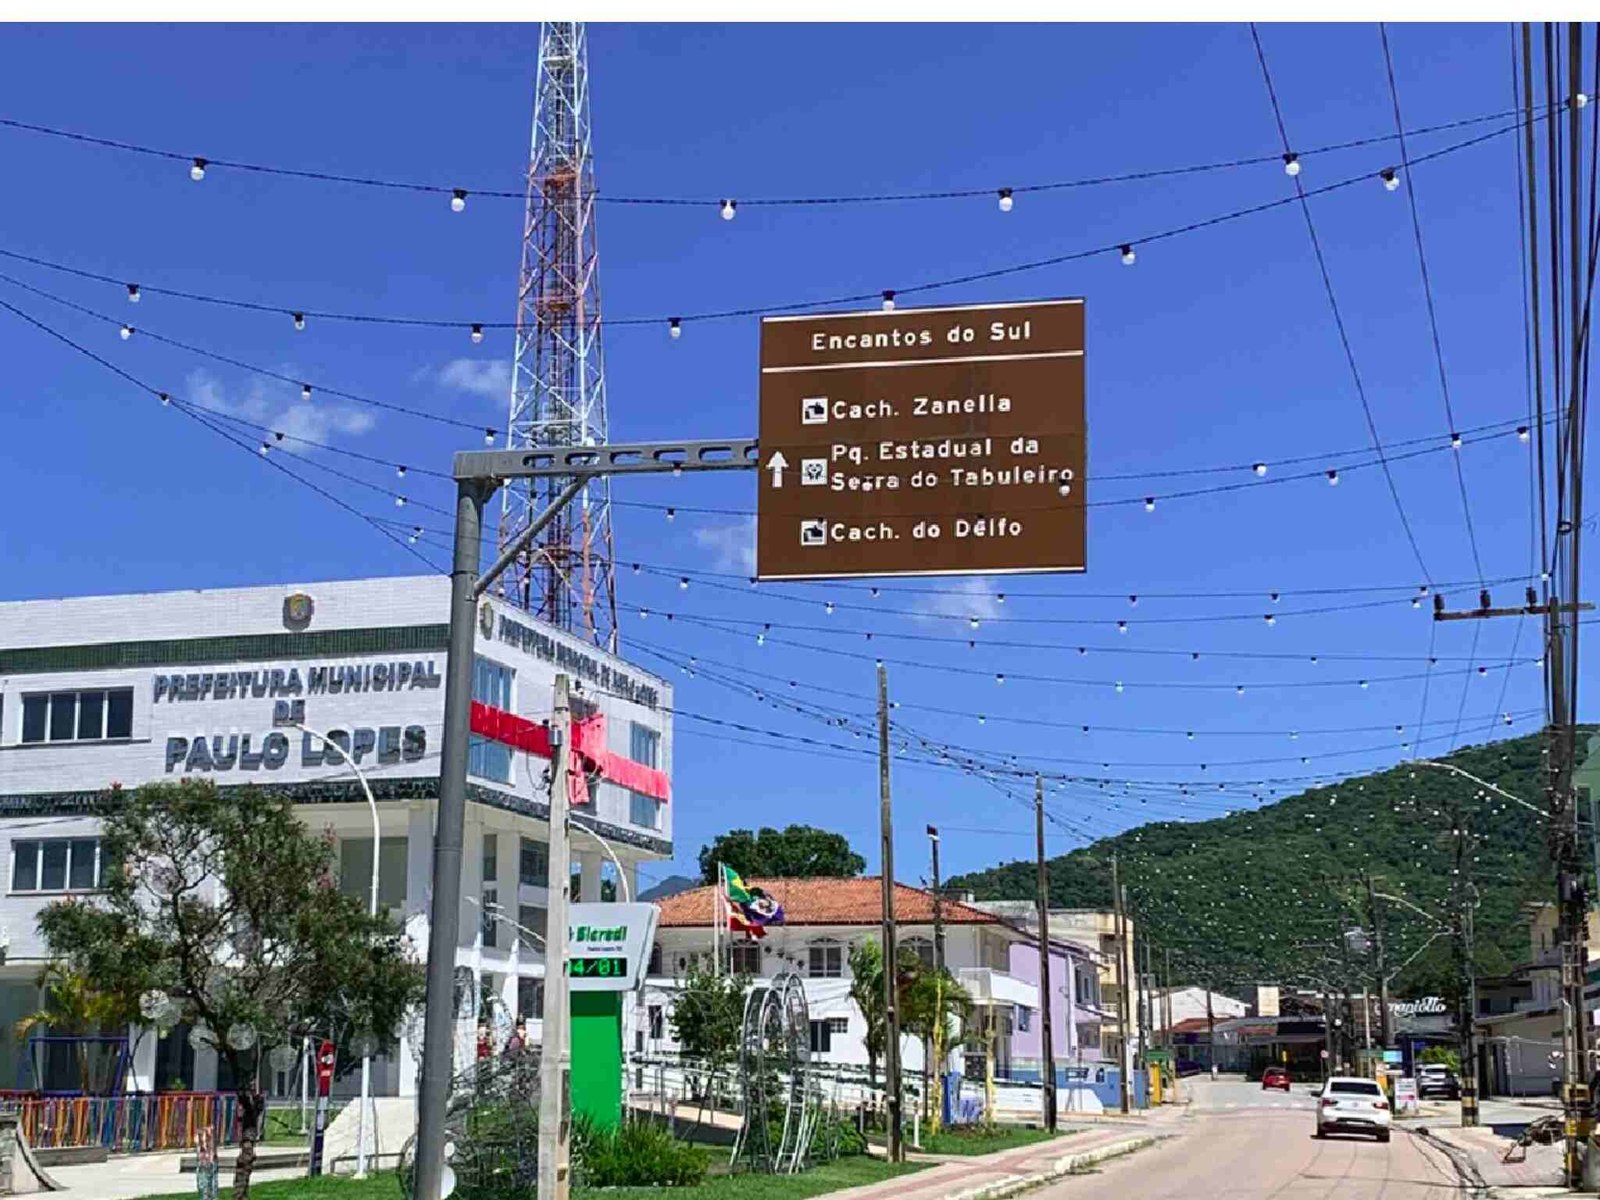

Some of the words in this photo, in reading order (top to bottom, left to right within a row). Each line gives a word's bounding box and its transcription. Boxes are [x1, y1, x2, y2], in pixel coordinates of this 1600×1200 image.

[811, 328, 932, 351] Encantos
[947, 327, 975, 344] do
[989, 321, 1031, 341] Sul
[831, 400, 900, 419] Cach.
[913, 394, 1012, 416] Zanella
[830, 444, 869, 466] Pq.
[879, 438, 992, 461] Estadual
[1010, 437, 1039, 455] da
[830, 472, 900, 492] Sera
[911, 470, 938, 488] do
[951, 464, 1073, 487] Tabuleiro
[830, 523, 900, 542] Cach.
[912, 521, 941, 539] do
[154, 667, 303, 703] PREFEITURA
[307, 660, 442, 695] MUNICIPAL
[272, 699, 306, 727] DE
[165, 732, 290, 773] PAULO
[301, 725, 427, 767] LOPES
[567, 957, 621, 976] 4/01
